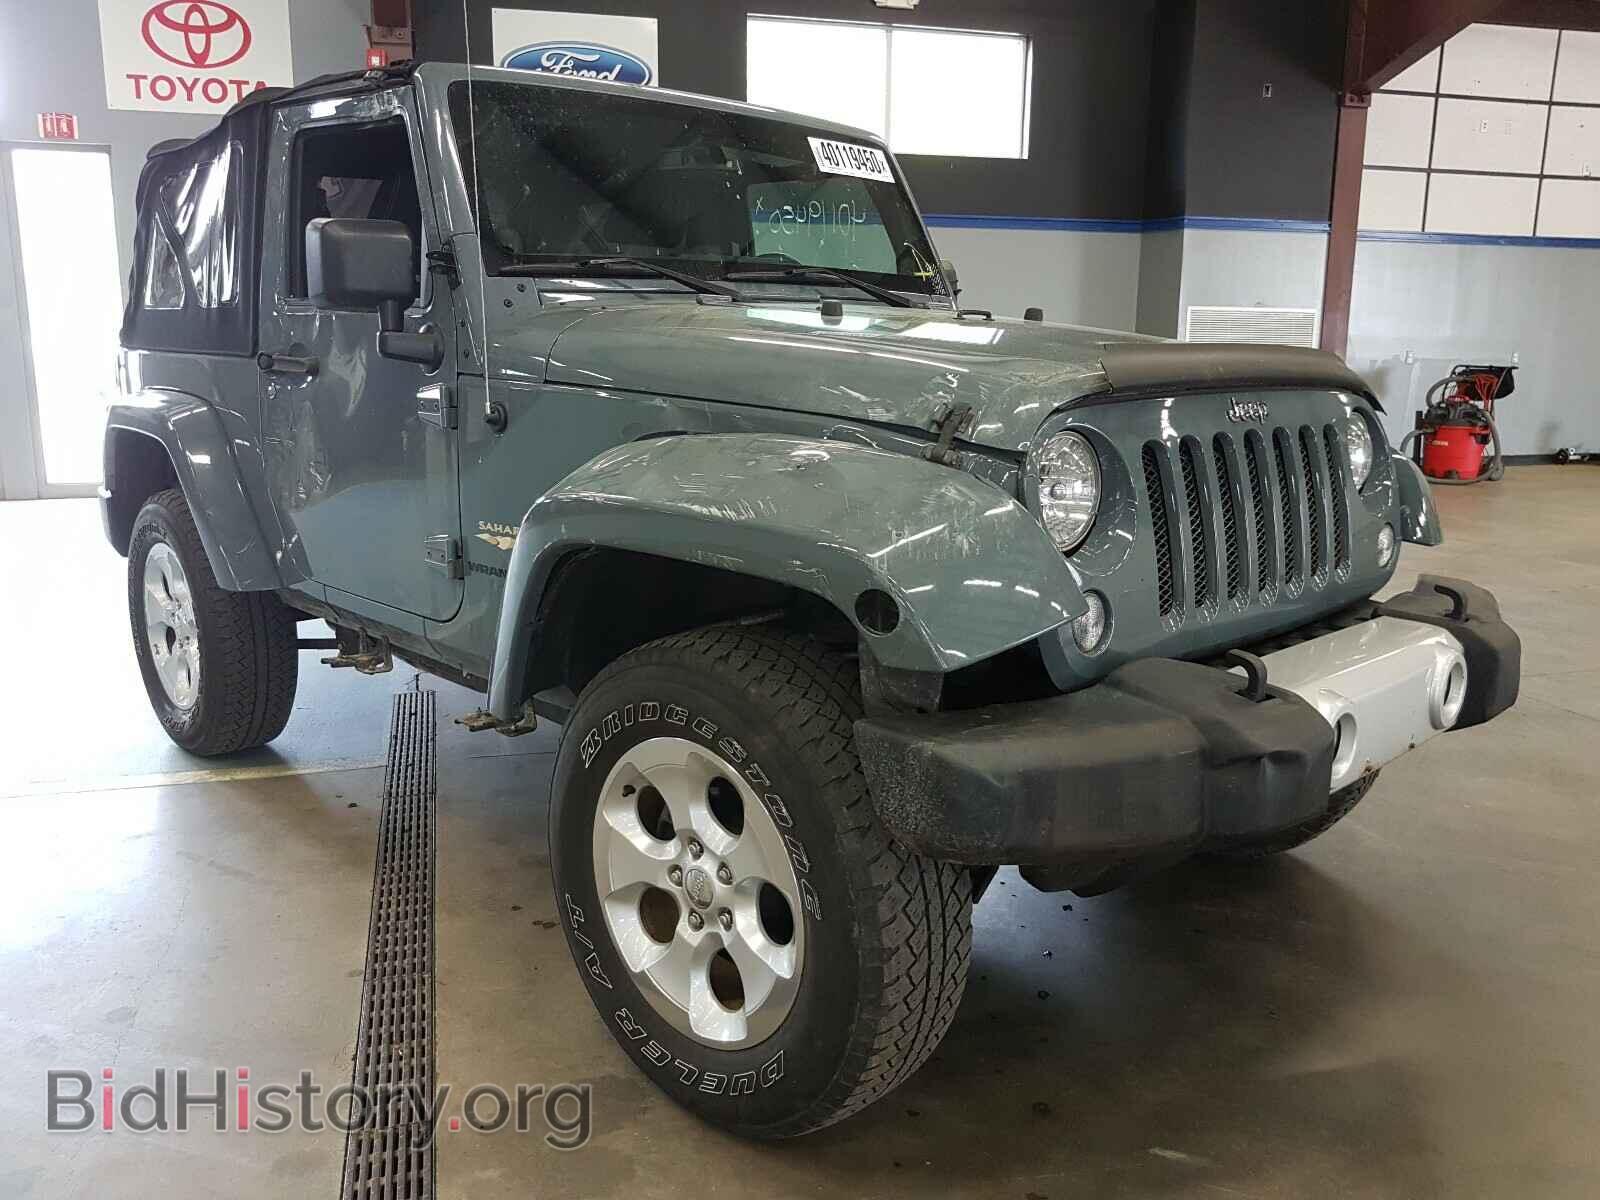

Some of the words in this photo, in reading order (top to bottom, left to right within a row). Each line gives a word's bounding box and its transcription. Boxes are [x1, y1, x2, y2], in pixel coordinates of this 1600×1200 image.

[820, 141, 882, 174] 40119450
[1225, 397, 1267, 425] Jeep
[579, 701, 823, 920] BRIDGESTONE
[614, 1007, 787, 1097] DUELER
